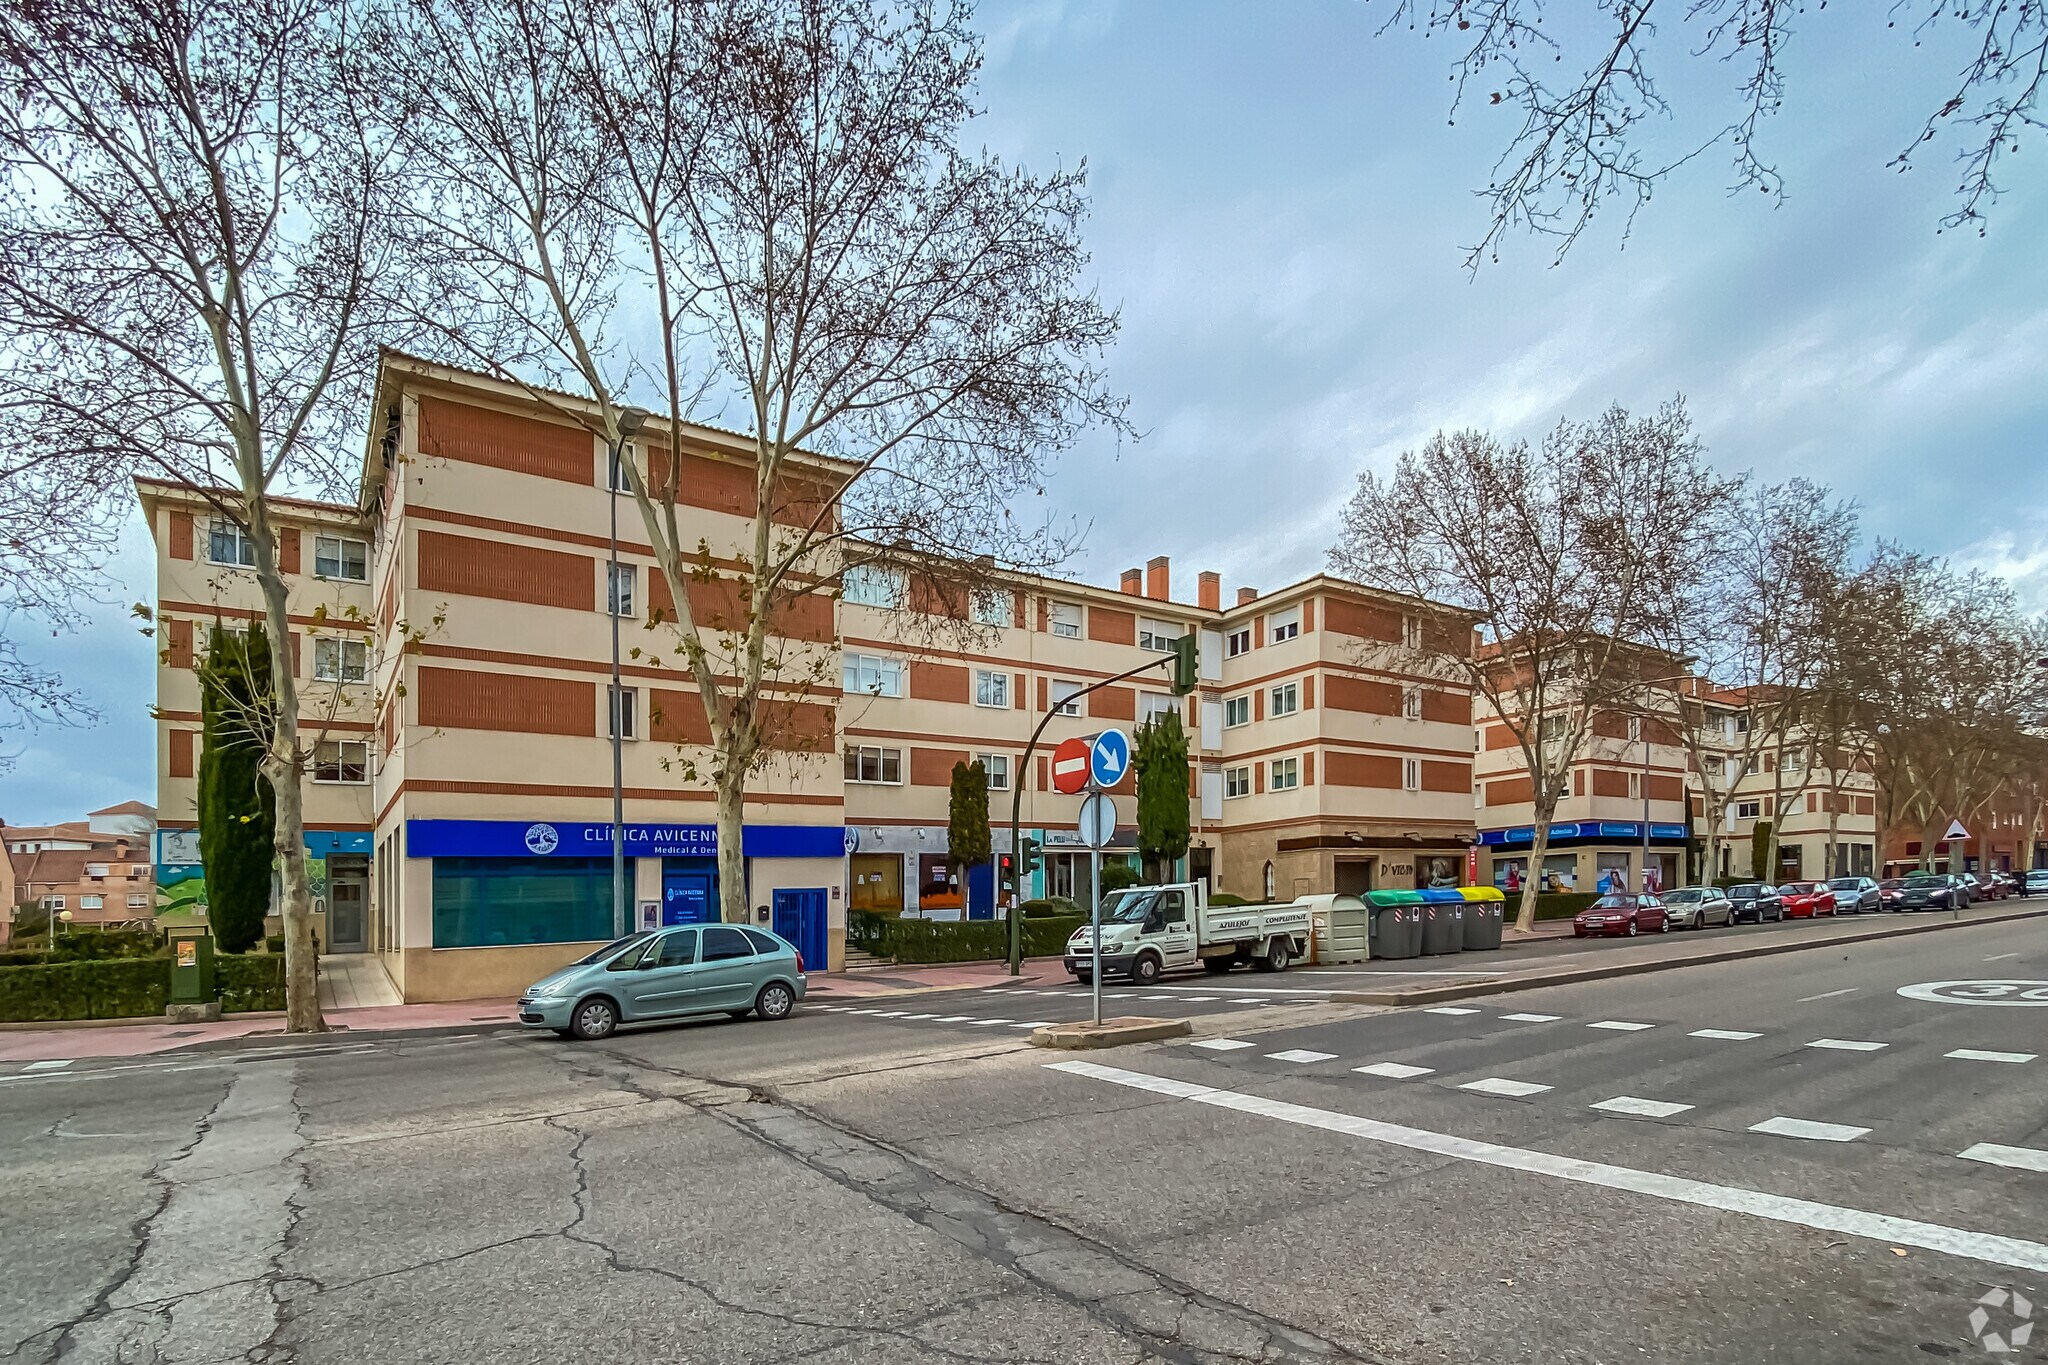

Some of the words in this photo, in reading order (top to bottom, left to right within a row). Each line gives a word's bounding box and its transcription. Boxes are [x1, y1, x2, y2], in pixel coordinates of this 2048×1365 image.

[584, 825, 649, 841] CLÍICA
[654, 846, 689, 854] Medical
[691, 846, 698, 854] &
[1219, 919, 1251, 929] AZULEJOS
